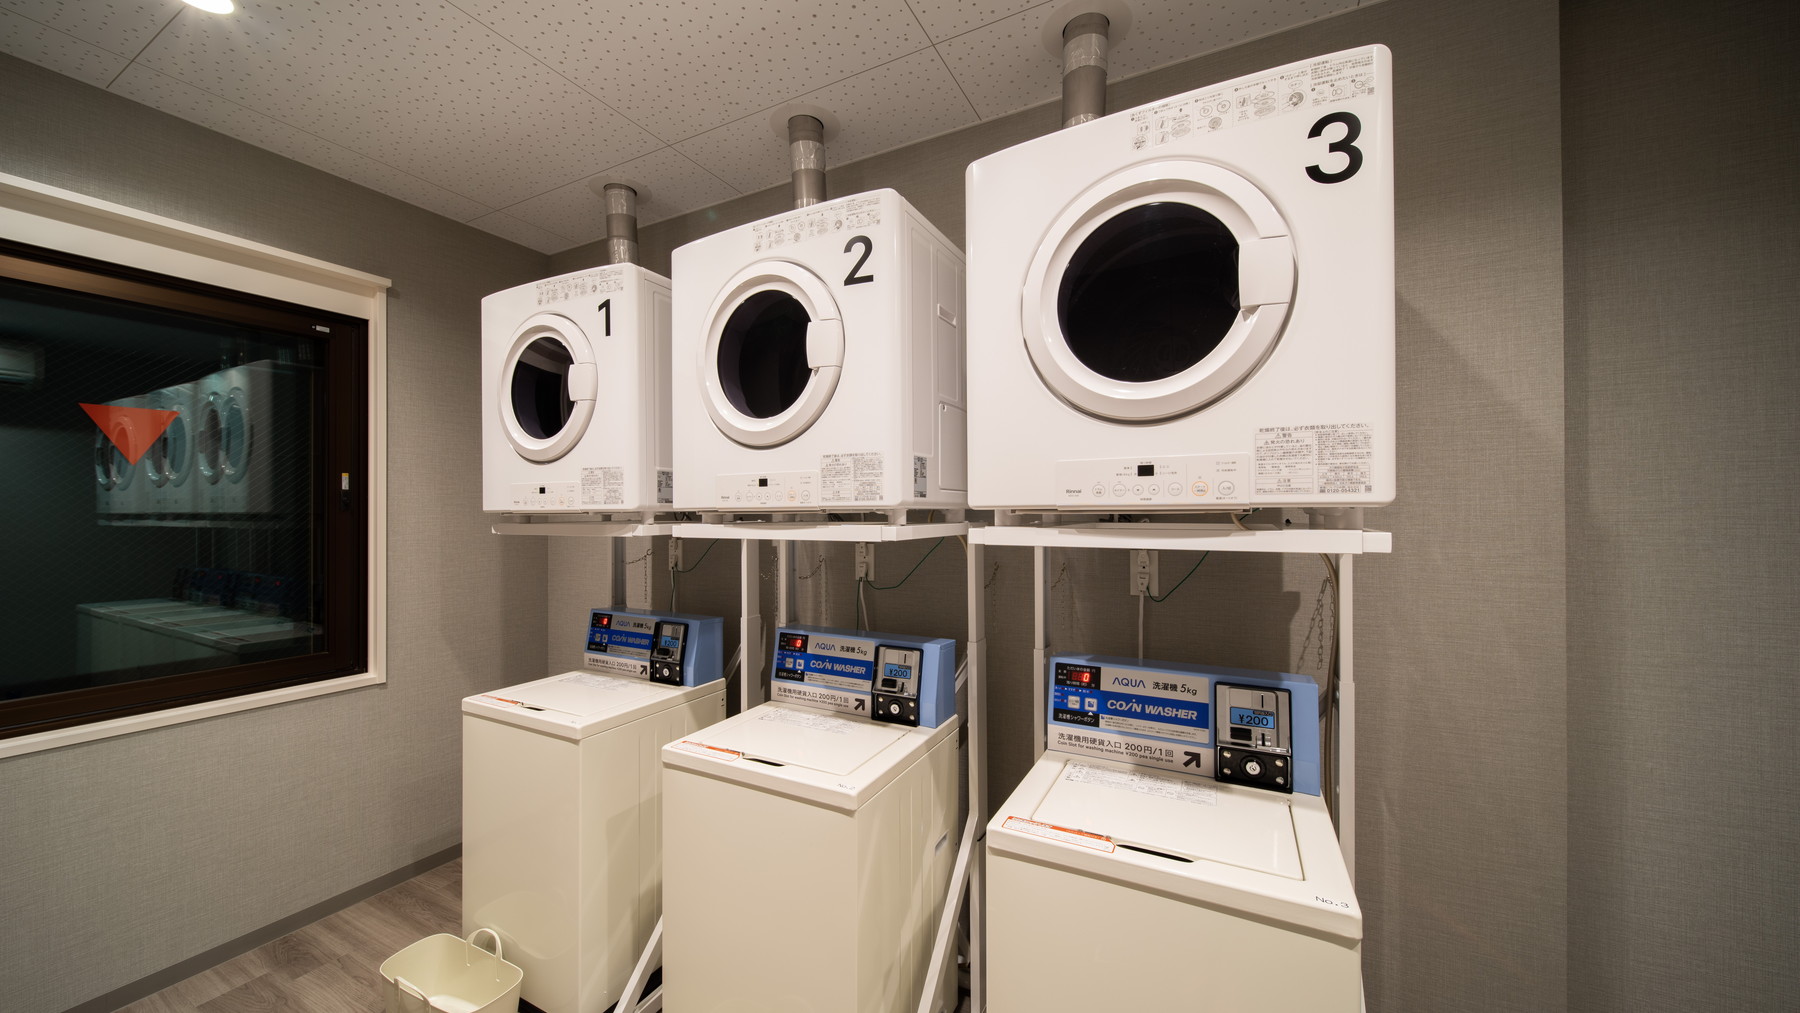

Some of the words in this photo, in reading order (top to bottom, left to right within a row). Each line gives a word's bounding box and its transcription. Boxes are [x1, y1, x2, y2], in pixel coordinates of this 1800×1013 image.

[1305, 111, 1363, 184] 3
[844, 235, 874, 286] 2
[598, 299, 611, 336] 1
[796, 639, 802, 648] 0
[814, 643, 836, 652] AQUA
[856, 647, 868, 656] 5kg
[833, 664, 866, 675] WASHER
[889, 668, 907, 678] ¥200
[1083, 672, 1090, 682] 0
[1112, 677, 1146, 689] AQUA
[1152, 681, 1178, 692] 洗濯機
[1179, 684, 1198, 696] 5kg
[1145, 705, 1198, 720] WASHER
[1238, 714, 1269, 727] ¥200
[1057, 732, 1122, 749] 洗濯機用硬貨入口
[1124, 742, 1174, 758] 200円/1回
[1085, 744, 1104, 753] washing
[1104, 748, 1124, 756] machine
[1149, 755, 1164, 763] single
[1315, 896, 1350, 909] No.3
